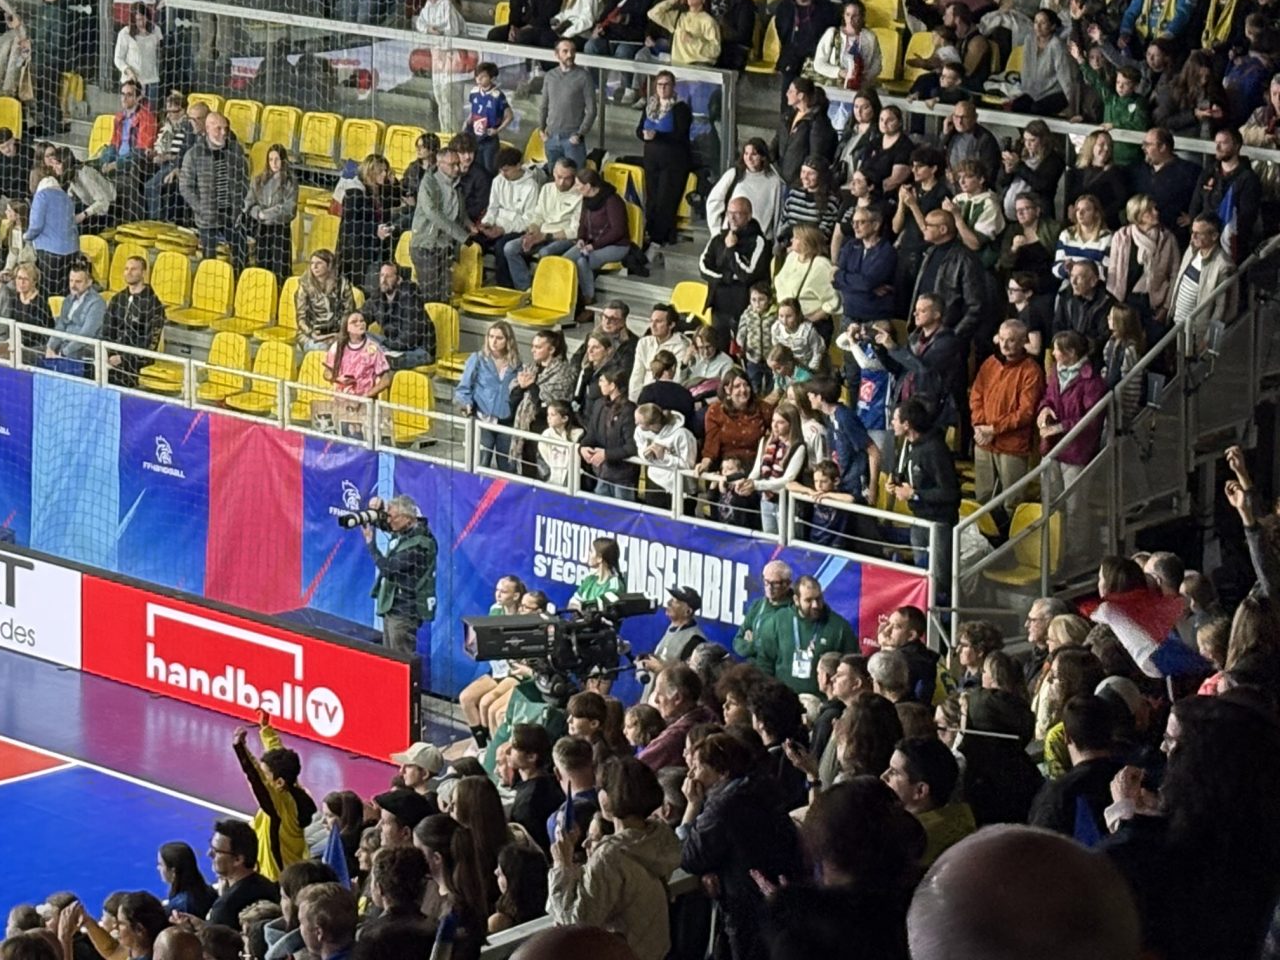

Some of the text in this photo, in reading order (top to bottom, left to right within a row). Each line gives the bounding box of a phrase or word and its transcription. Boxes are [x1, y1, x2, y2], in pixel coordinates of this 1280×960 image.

[533, 553, 591, 586] S'ÉCR
[146, 642, 338, 724] handball TV
